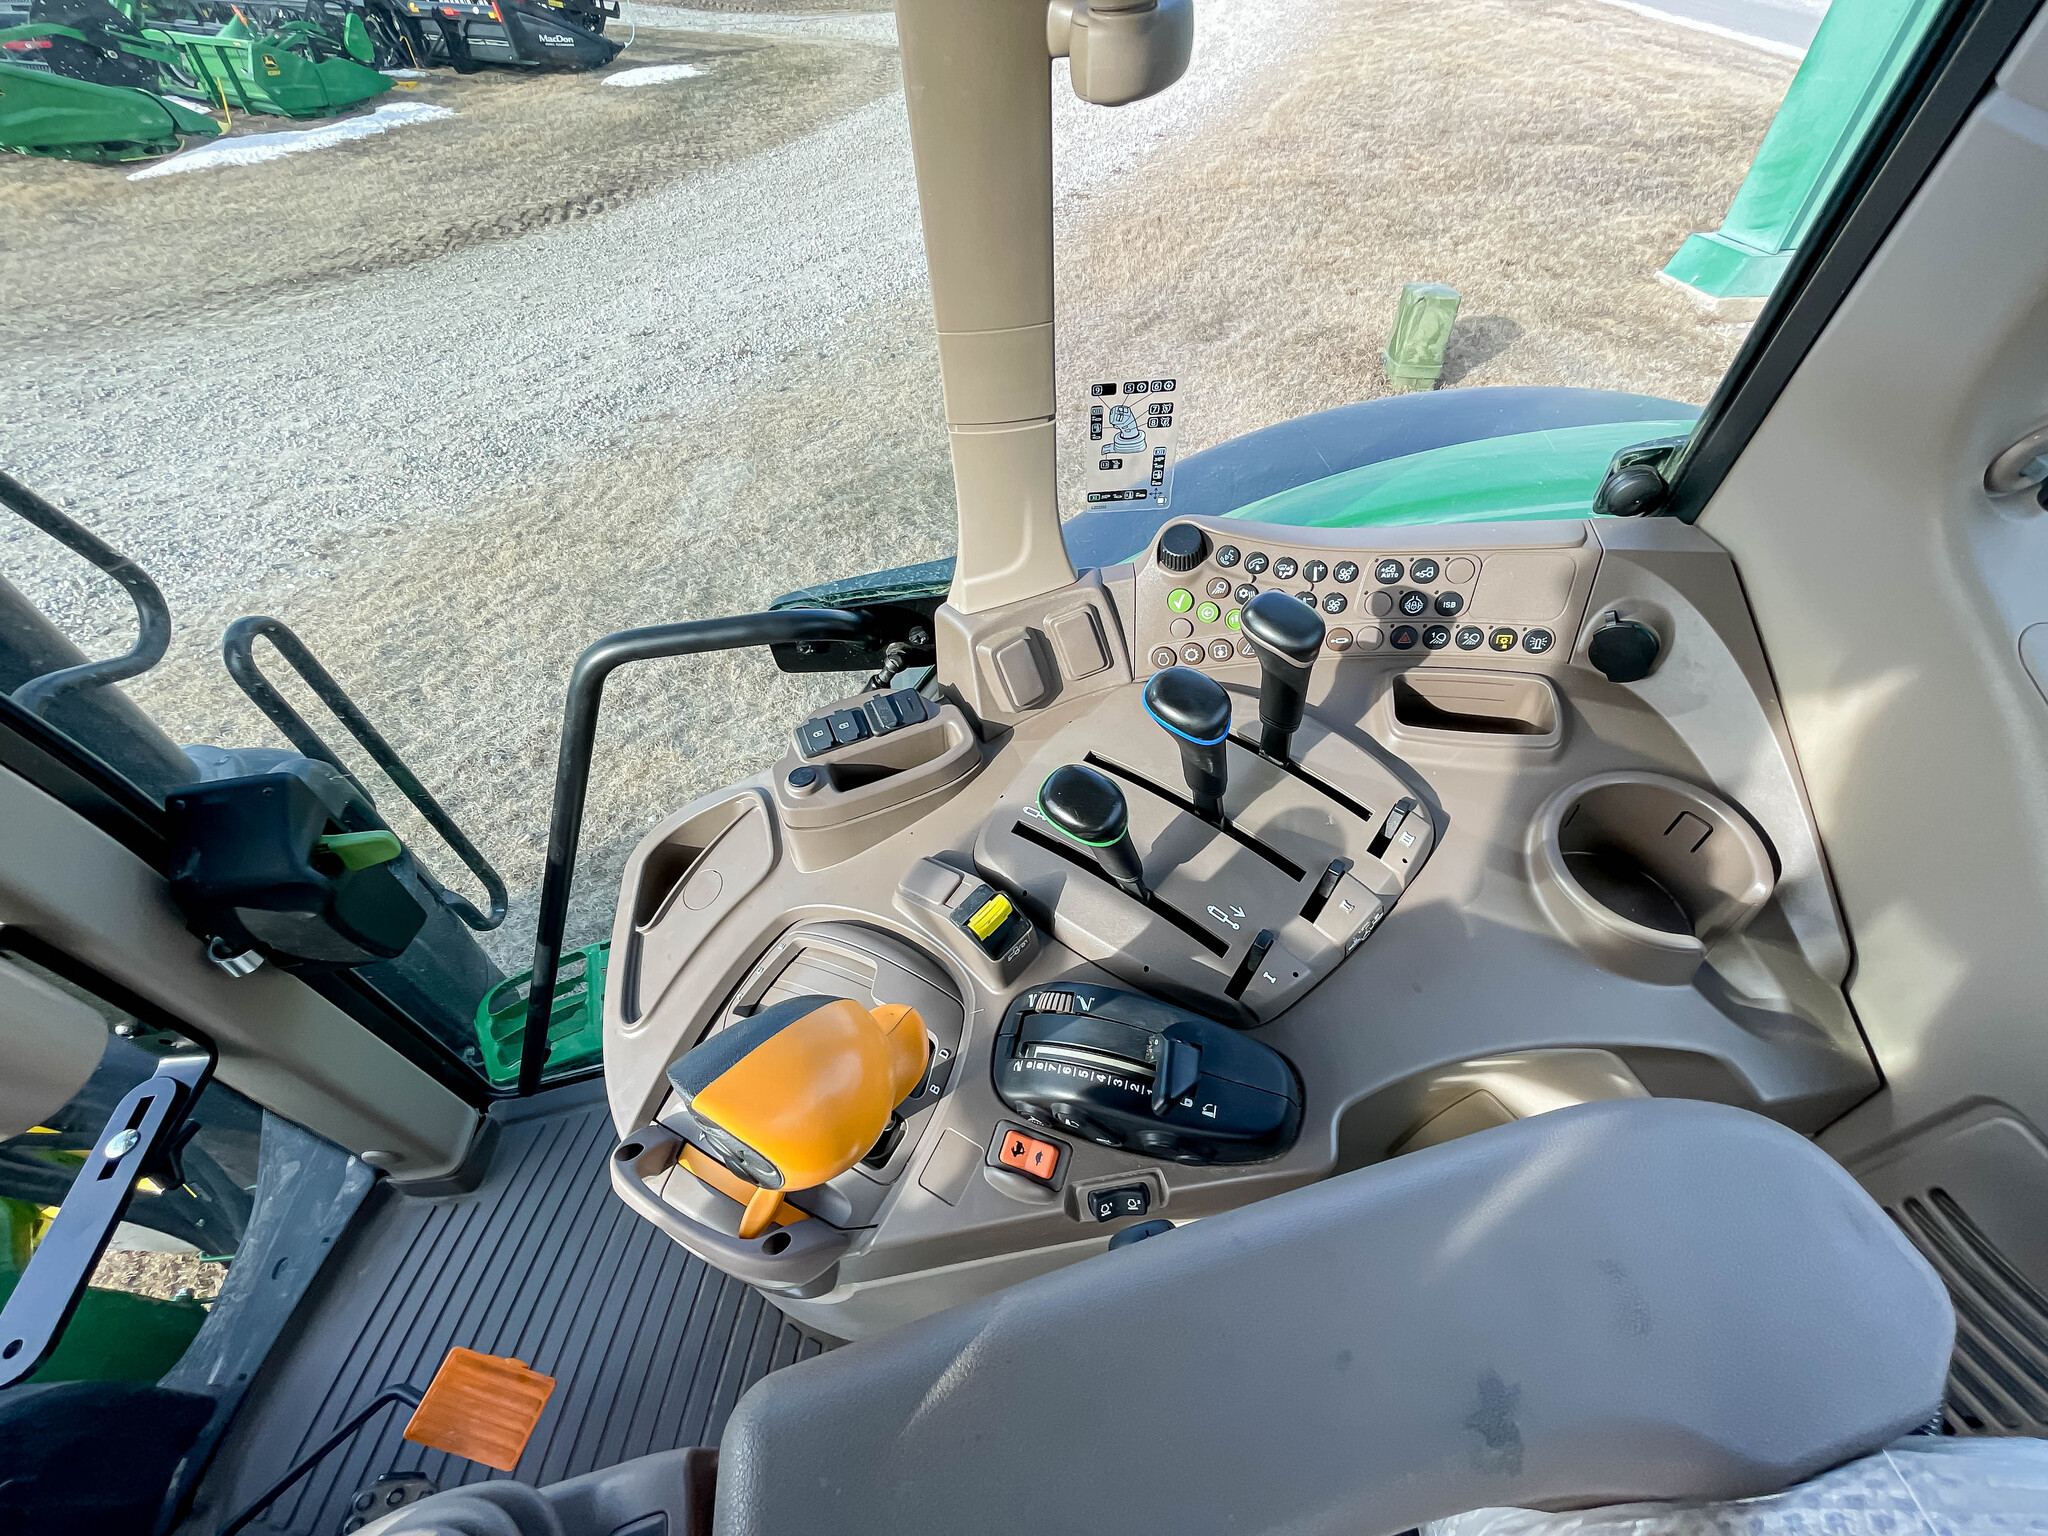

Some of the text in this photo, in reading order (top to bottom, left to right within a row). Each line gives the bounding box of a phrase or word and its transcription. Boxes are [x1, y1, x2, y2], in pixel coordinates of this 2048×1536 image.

[538, 34, 574, 43] MacDon
[1399, 831, 1416, 847] III
[1339, 899, 1355, 914] II
[938, 1048, 949, 1059] D
[1062, 1066, 1072, 1074] 6
[1078, 1068, 1088, 1079] 5
[1096, 1074, 1106, 1083] 4
[1113, 1078, 1123, 1087] 3
[1130, 1083, 1140, 1092] 2
[929, 1084, 940, 1095] B
